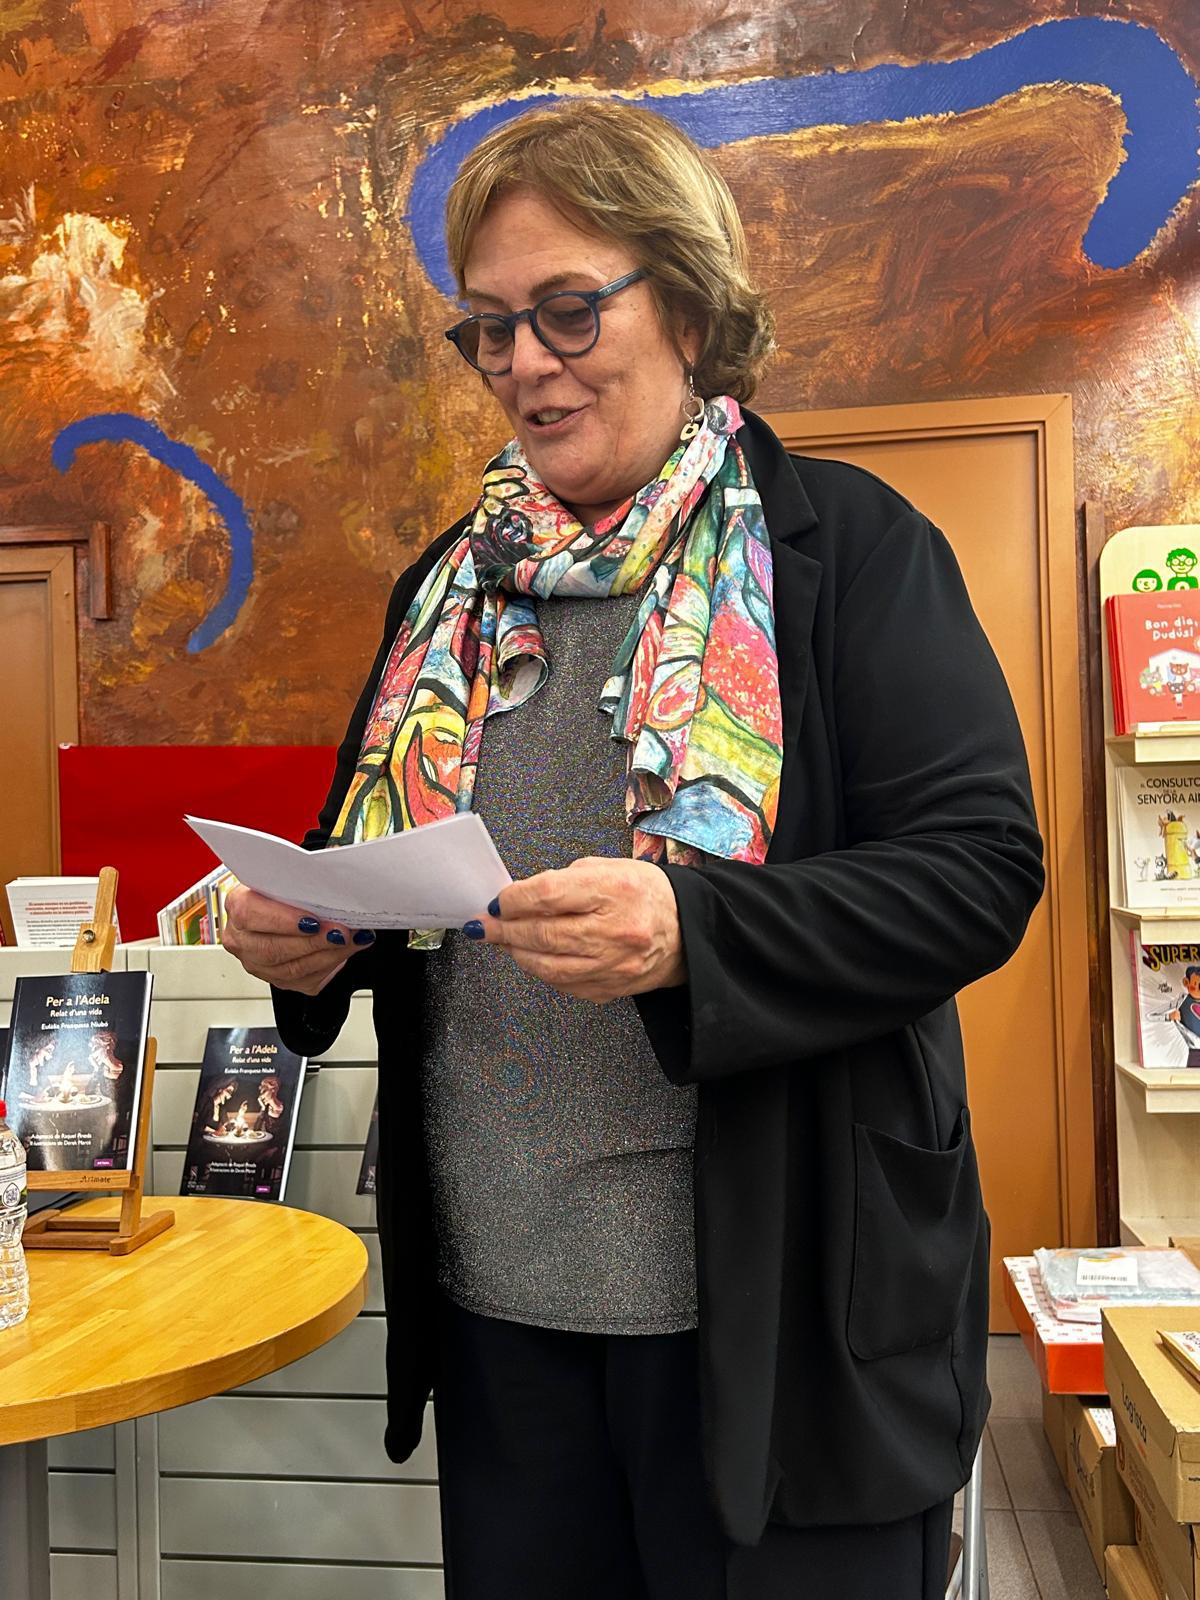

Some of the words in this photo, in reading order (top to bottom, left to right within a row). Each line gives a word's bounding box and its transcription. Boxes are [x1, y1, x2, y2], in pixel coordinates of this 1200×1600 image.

[1145, 619, 1168, 630] Bon
[1137, 793, 1186, 805] SENYORA
[46, 997, 64, 1007] Per
[66, 998, 73, 1006] a
[75, 994, 110, 1006] l'Adela
[50, 1009, 68, 1017] Relat
[69, 1008, 87, 1016] d'una
[89, 1007, 103, 1015] vida
[230, 1045, 244, 1054] Per
[251, 1044, 278, 1054] l'Adela
